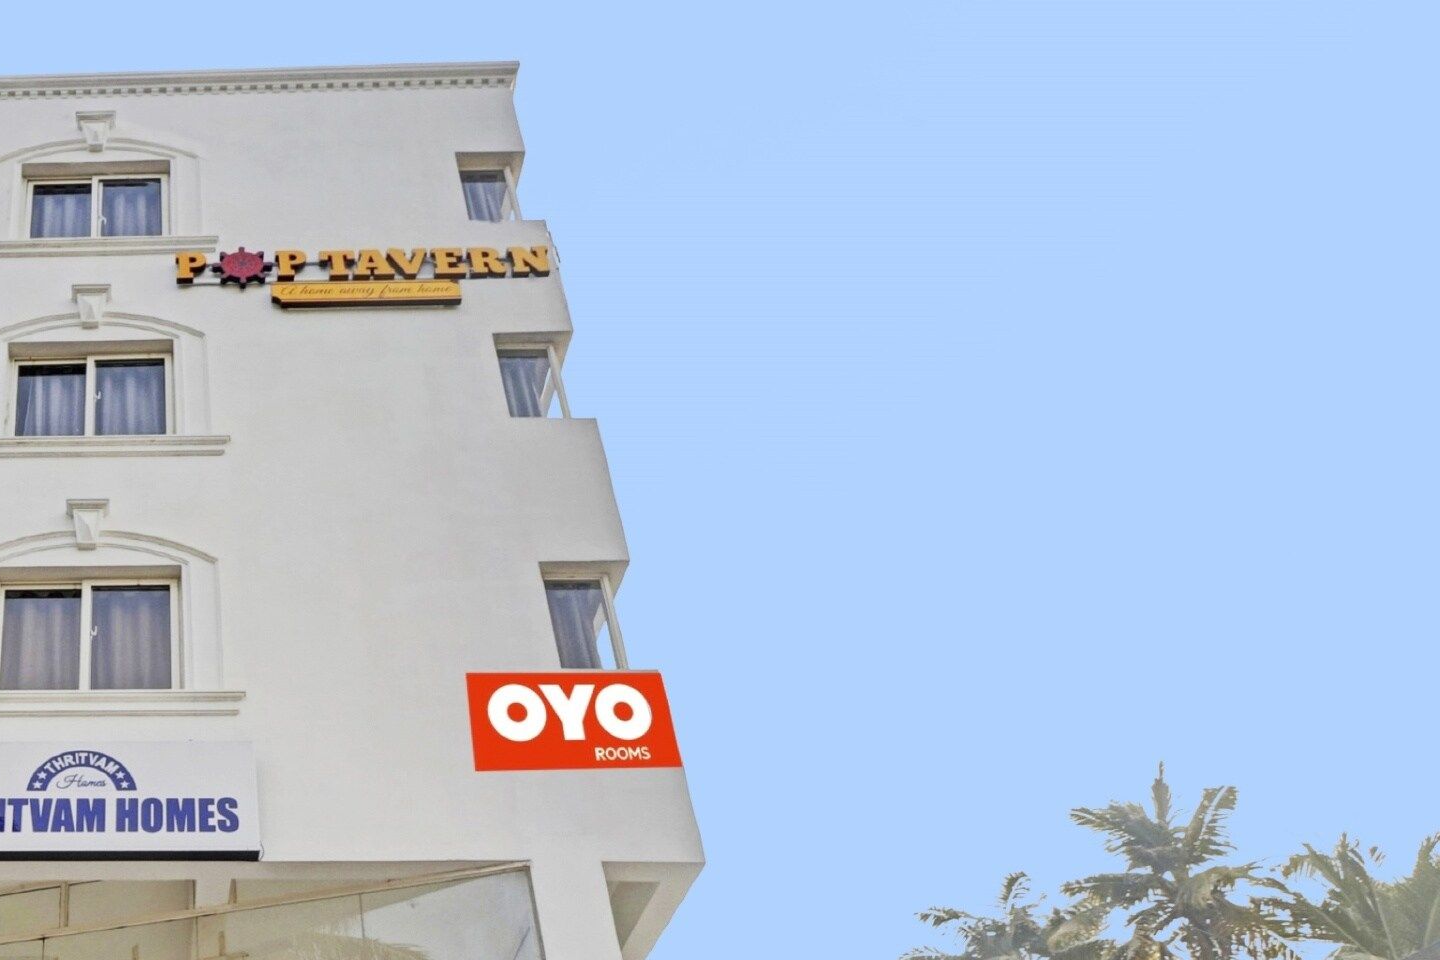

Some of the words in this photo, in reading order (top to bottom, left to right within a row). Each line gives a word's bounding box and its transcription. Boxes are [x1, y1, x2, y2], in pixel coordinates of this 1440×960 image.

[319, 246, 549, 282] TAVERN
[300, 283, 333, 295] home
[339, 286, 375, 298] away
[379, 284, 411, 299] from
[417, 283, 452, 294] home
[487, 683, 653, 742] OYO
[43, 752, 120, 775] THRITVAM
[594, 746, 652, 762] ROOMS
[115, 797, 240, 833] HOMES
